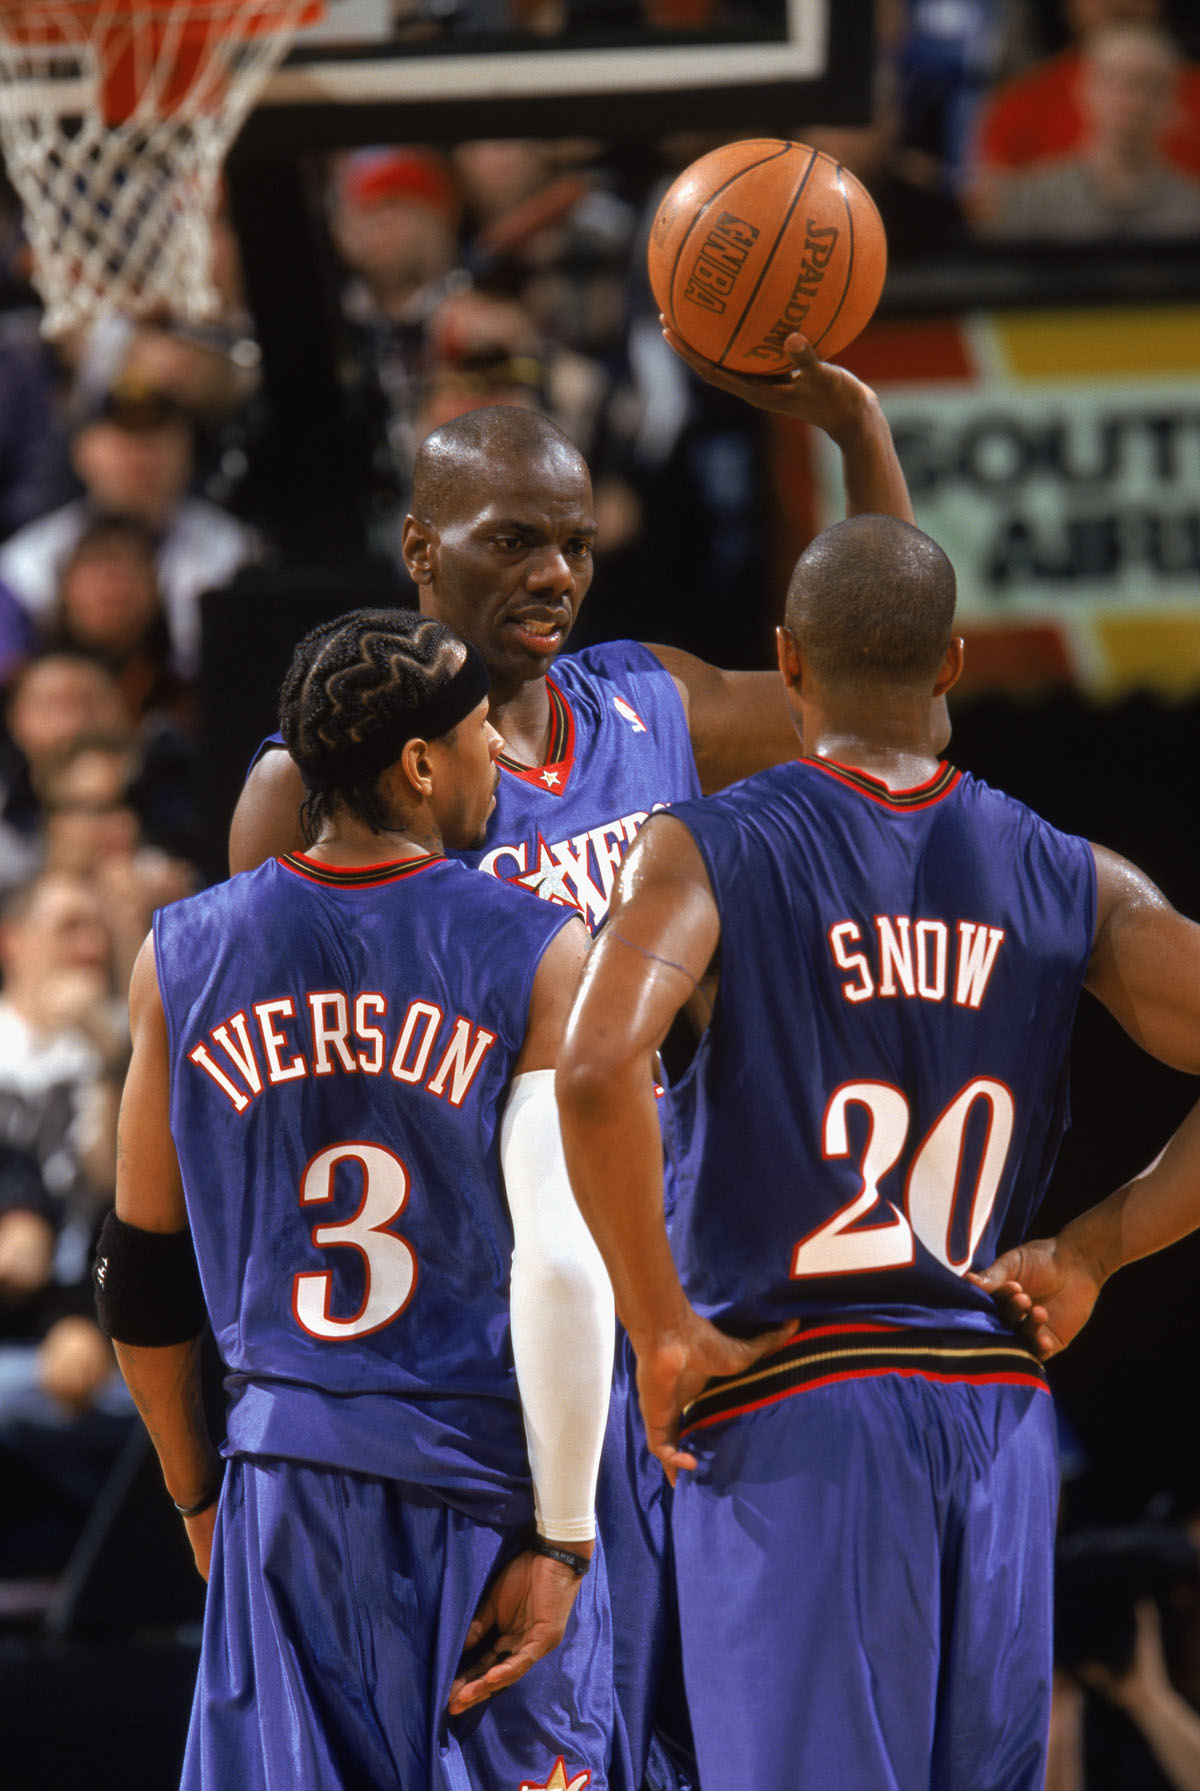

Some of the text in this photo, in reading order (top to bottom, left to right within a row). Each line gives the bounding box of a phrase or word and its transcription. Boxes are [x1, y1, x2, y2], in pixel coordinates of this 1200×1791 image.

[684, 230, 750, 315] NBA
[743, 218, 838, 362] SPALDING
[828, 914, 1005, 1011] SNOW
[188, 989, 498, 1115] IVERSON
[292, 1140, 419, 1341] 3
[789, 1075, 1015, 1280] 20
